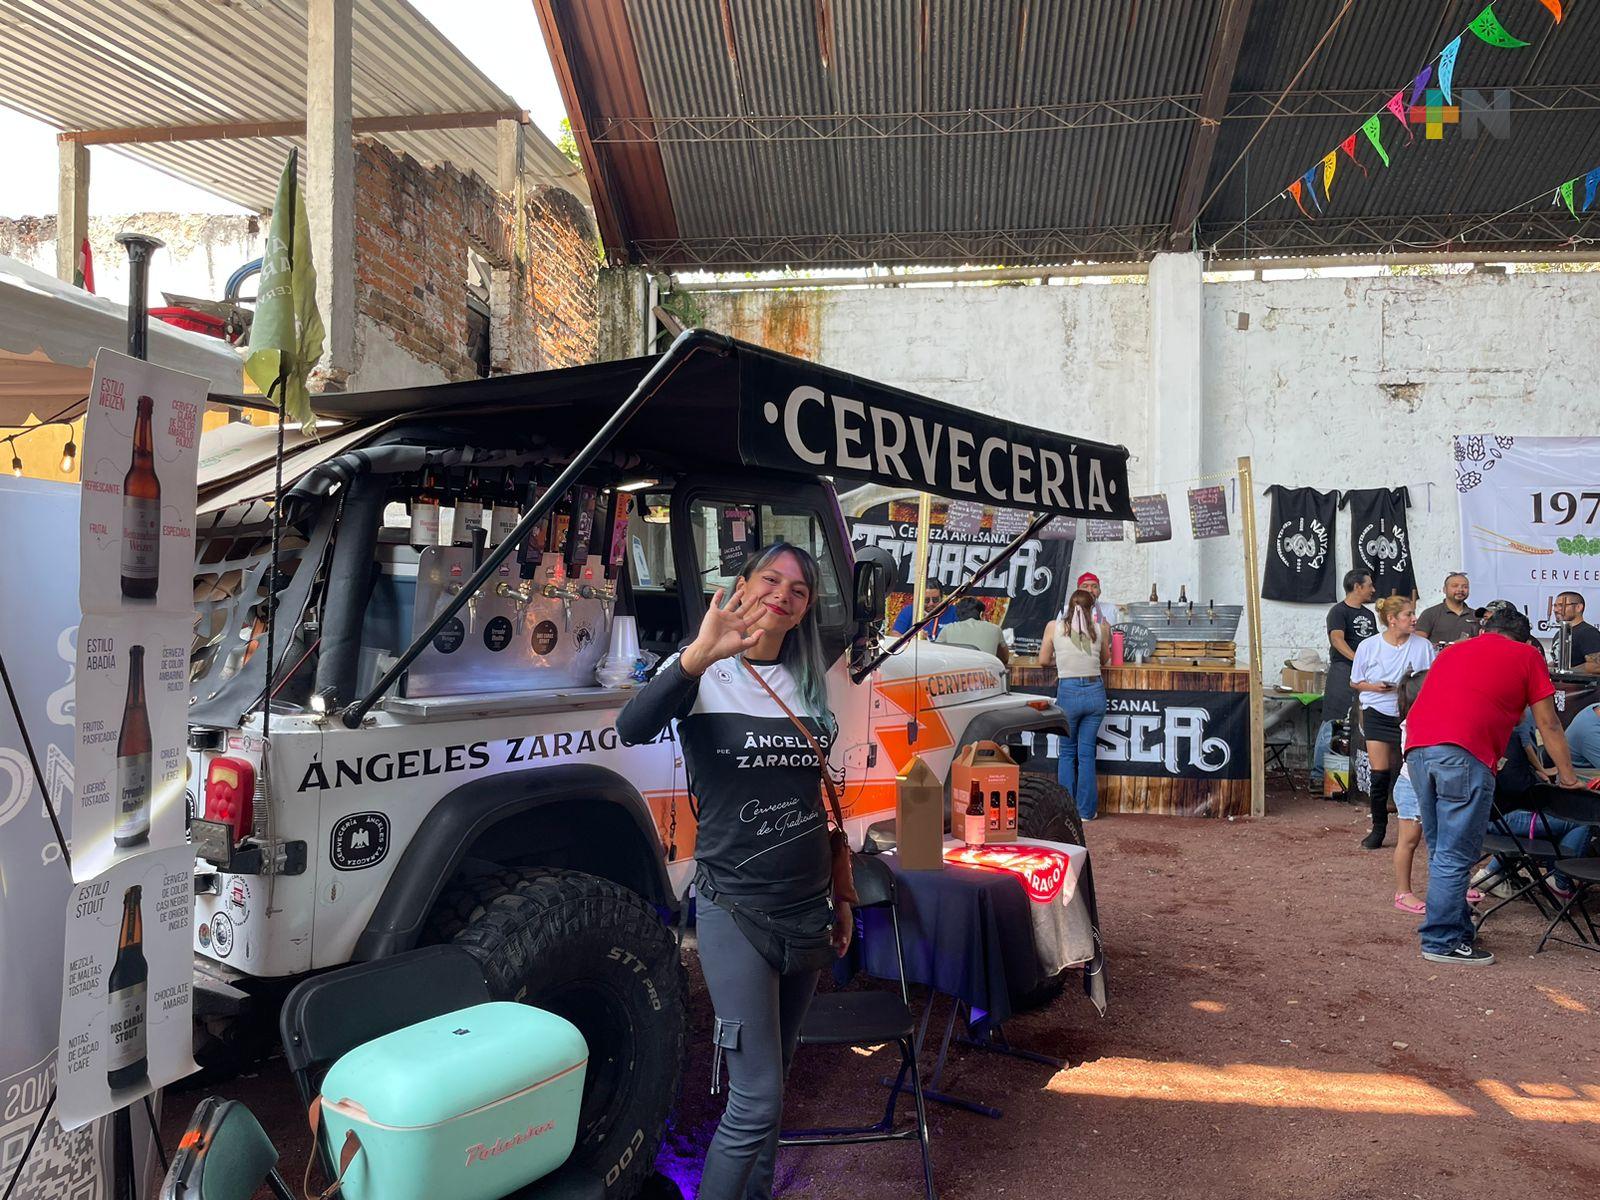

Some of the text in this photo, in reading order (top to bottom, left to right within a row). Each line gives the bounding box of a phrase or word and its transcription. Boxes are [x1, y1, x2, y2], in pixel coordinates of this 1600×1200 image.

[101, 377, 125, 396] ESTILO
[99, 392, 126, 412] WEIZEN
[84, 479, 121, 495] REFRESCANTE
[89, 523, 109, 536] FRUTAL
[899, 523, 949, 541] CEEZA
[86, 638, 114, 653] ESTILO
[86, 653, 117, 671] ABADÍA
[1105, 699, 1160, 713] ESANAL
[82, 720, 105, 733] FRUTOS
[82, 731, 118, 745] PASIFICADOS
[296, 721, 676, 793] ÁNGELES ZARAGA
[82, 780, 107, 795] LIGEROS
[81, 792, 111, 808] TOSTADOS
[757, 821, 774, 836] de
[163, 871, 188, 887] CERVEZA
[79, 880, 110, 901] ESTILO
[162, 882, 188, 899] DE COLOR
[76, 897, 105, 919] STOUT
[160, 913, 168, 923] DE
[69, 955, 94, 972] MEZCLA
[69, 964, 103, 986] DE MALTAS
[607, 946, 662, 1011] STT PRO
[68, 977, 100, 998] TOSTADAS
[153, 982, 189, 1003] CHOCOLATE
[162, 994, 189, 1012] AMARGO
[68, 1032, 89, 1049] NOTAS
[115, 1027, 138, 1044] STOUT
[68, 1040, 100, 1062] DE CACAO
[68, 1064, 73, 1074] Y
[602, 1128, 645, 1188] COO
